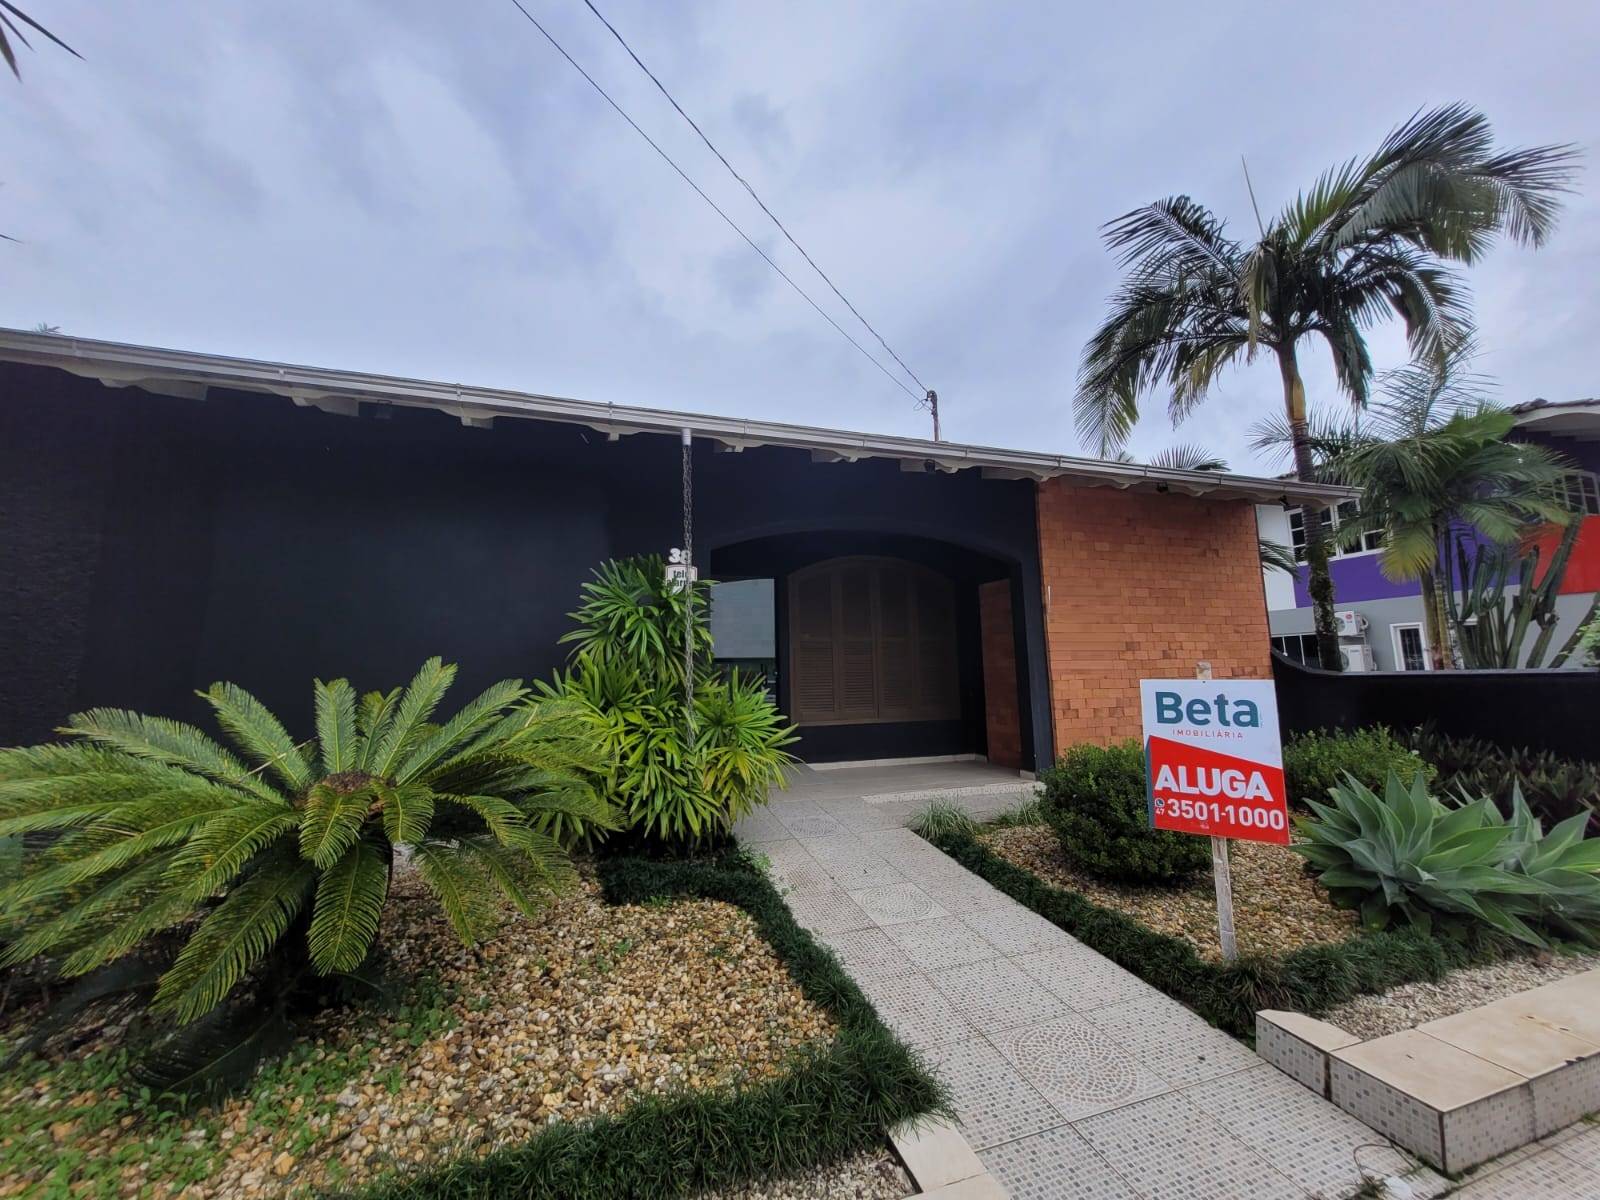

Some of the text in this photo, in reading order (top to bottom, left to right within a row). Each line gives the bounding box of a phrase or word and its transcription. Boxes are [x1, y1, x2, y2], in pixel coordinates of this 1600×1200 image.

[1155, 691, 1259, 728] Beta
[1154, 765, 1274, 802] ALUGA
[1167, 798, 1284, 830] 3501-1000
